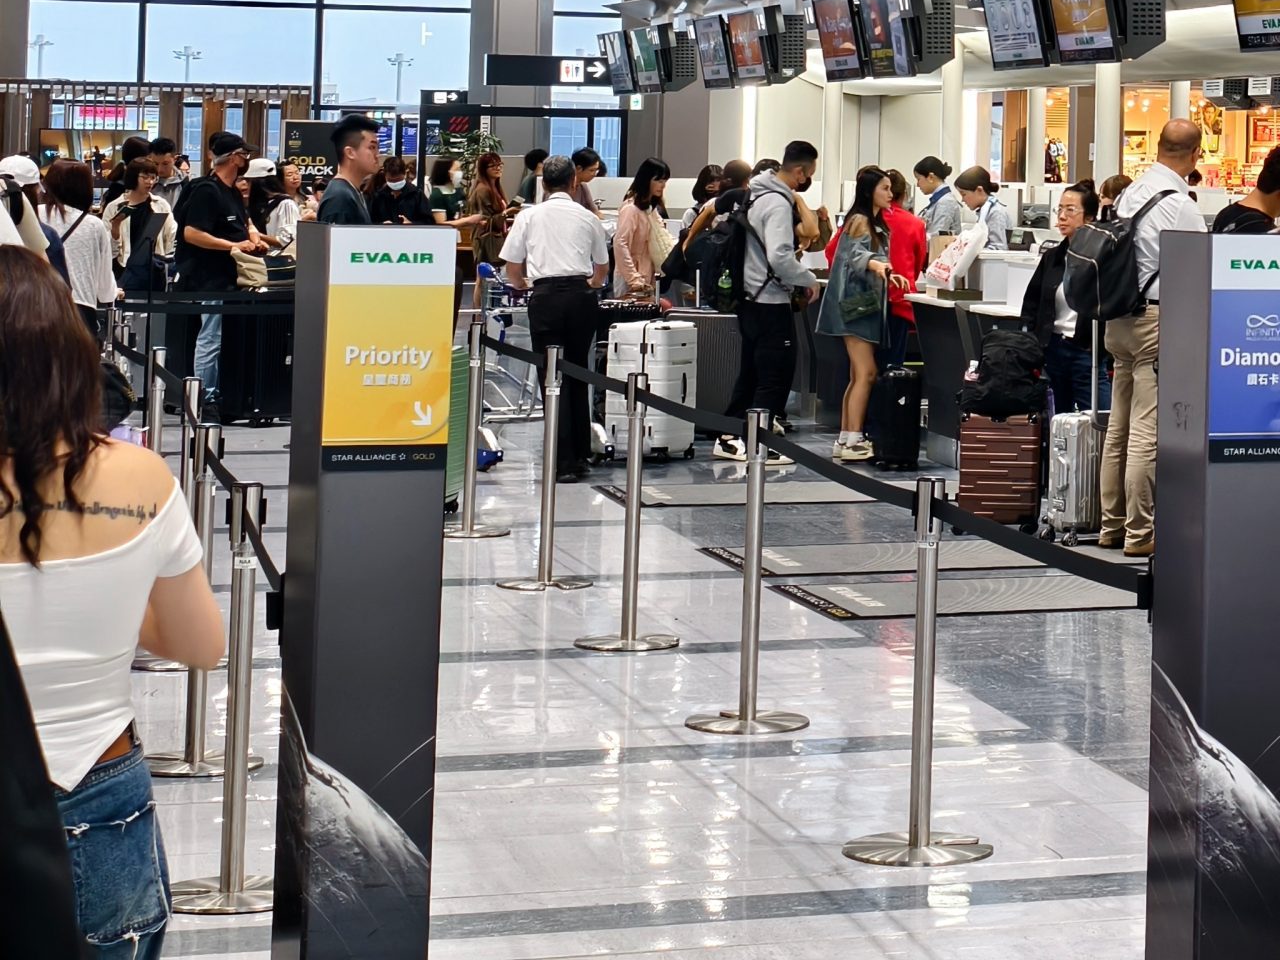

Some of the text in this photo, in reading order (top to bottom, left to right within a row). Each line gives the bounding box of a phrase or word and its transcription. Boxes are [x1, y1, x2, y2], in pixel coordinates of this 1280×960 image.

[288, 156, 326, 166] GOLD
[299, 166, 334, 175] RACK
[1246, 328, 1280, 337] INFINITY
[345, 345, 433, 370] Priority
[1223, 448, 1246, 456] STAR
[331, 453, 435, 462] STAR ALLIANCE GOLD
